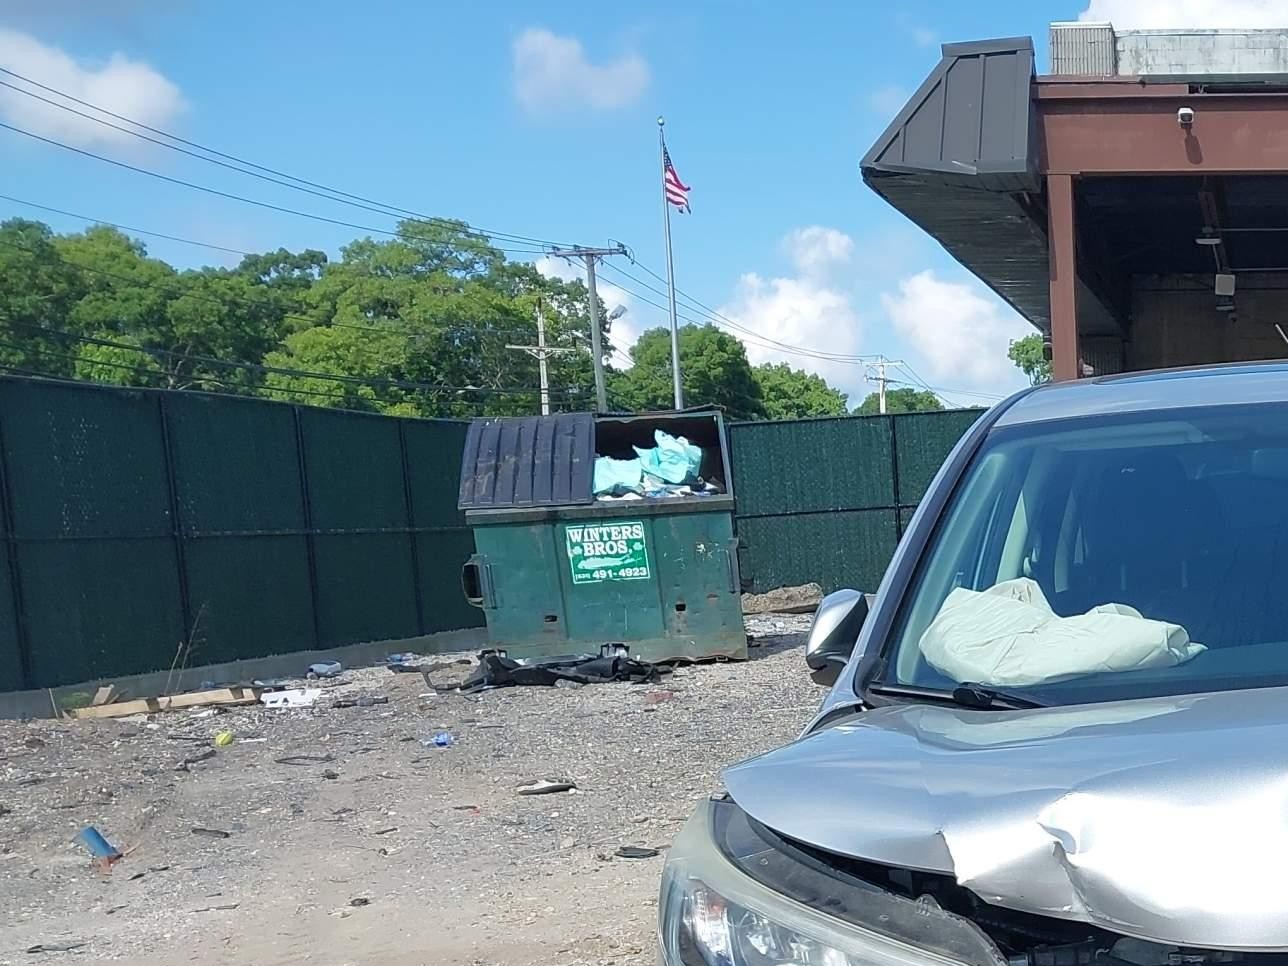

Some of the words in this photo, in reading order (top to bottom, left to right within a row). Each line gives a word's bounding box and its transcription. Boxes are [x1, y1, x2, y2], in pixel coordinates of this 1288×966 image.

[568, 525, 643, 542] WINTERS
[582, 540, 632, 556] BROS.
[592, 567, 647, 579] 491-4923
